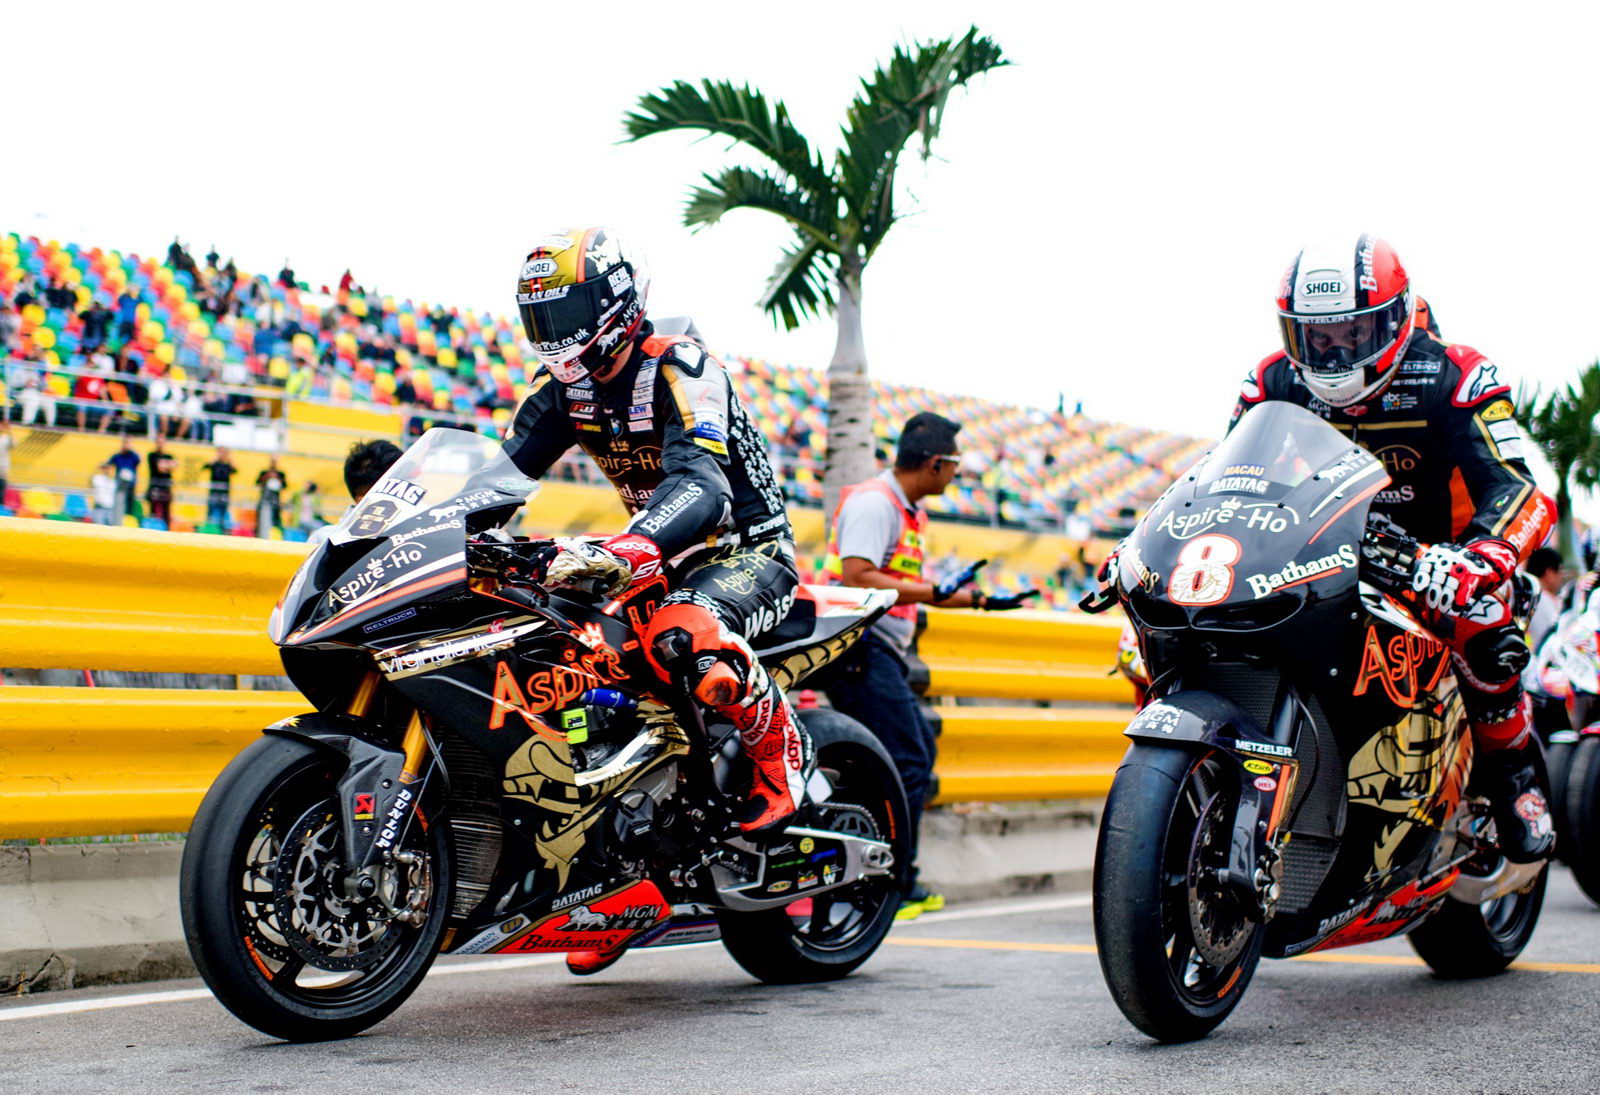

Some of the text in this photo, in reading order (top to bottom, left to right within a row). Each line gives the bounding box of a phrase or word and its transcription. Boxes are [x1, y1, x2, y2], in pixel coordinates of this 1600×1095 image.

[526, 262, 550, 275] SHOEI
[544, 285, 571, 297] OILS
[1306, 282, 1341, 294] SHOEI
[1402, 363, 1438, 371] ELTRUCK
[1223, 465, 1265, 476] MACAU
[1209, 477, 1270, 492] DATATAG
[464, 490, 500, 504] MGM
[1157, 504, 1287, 540] Aspire-Ho
[713, 554, 769, 594] Aspire-H
[1167, 533, 1242, 607] 8
[327, 549, 422, 608] Aspire-Ho
[365, 610, 414, 632] KELTRUCK
[1235, 740, 1293, 757] METZELER
[375, 788, 412, 848] DUNLOP
[551, 882, 603, 909] DATATAG
[620, 903, 663, 919] MGM
